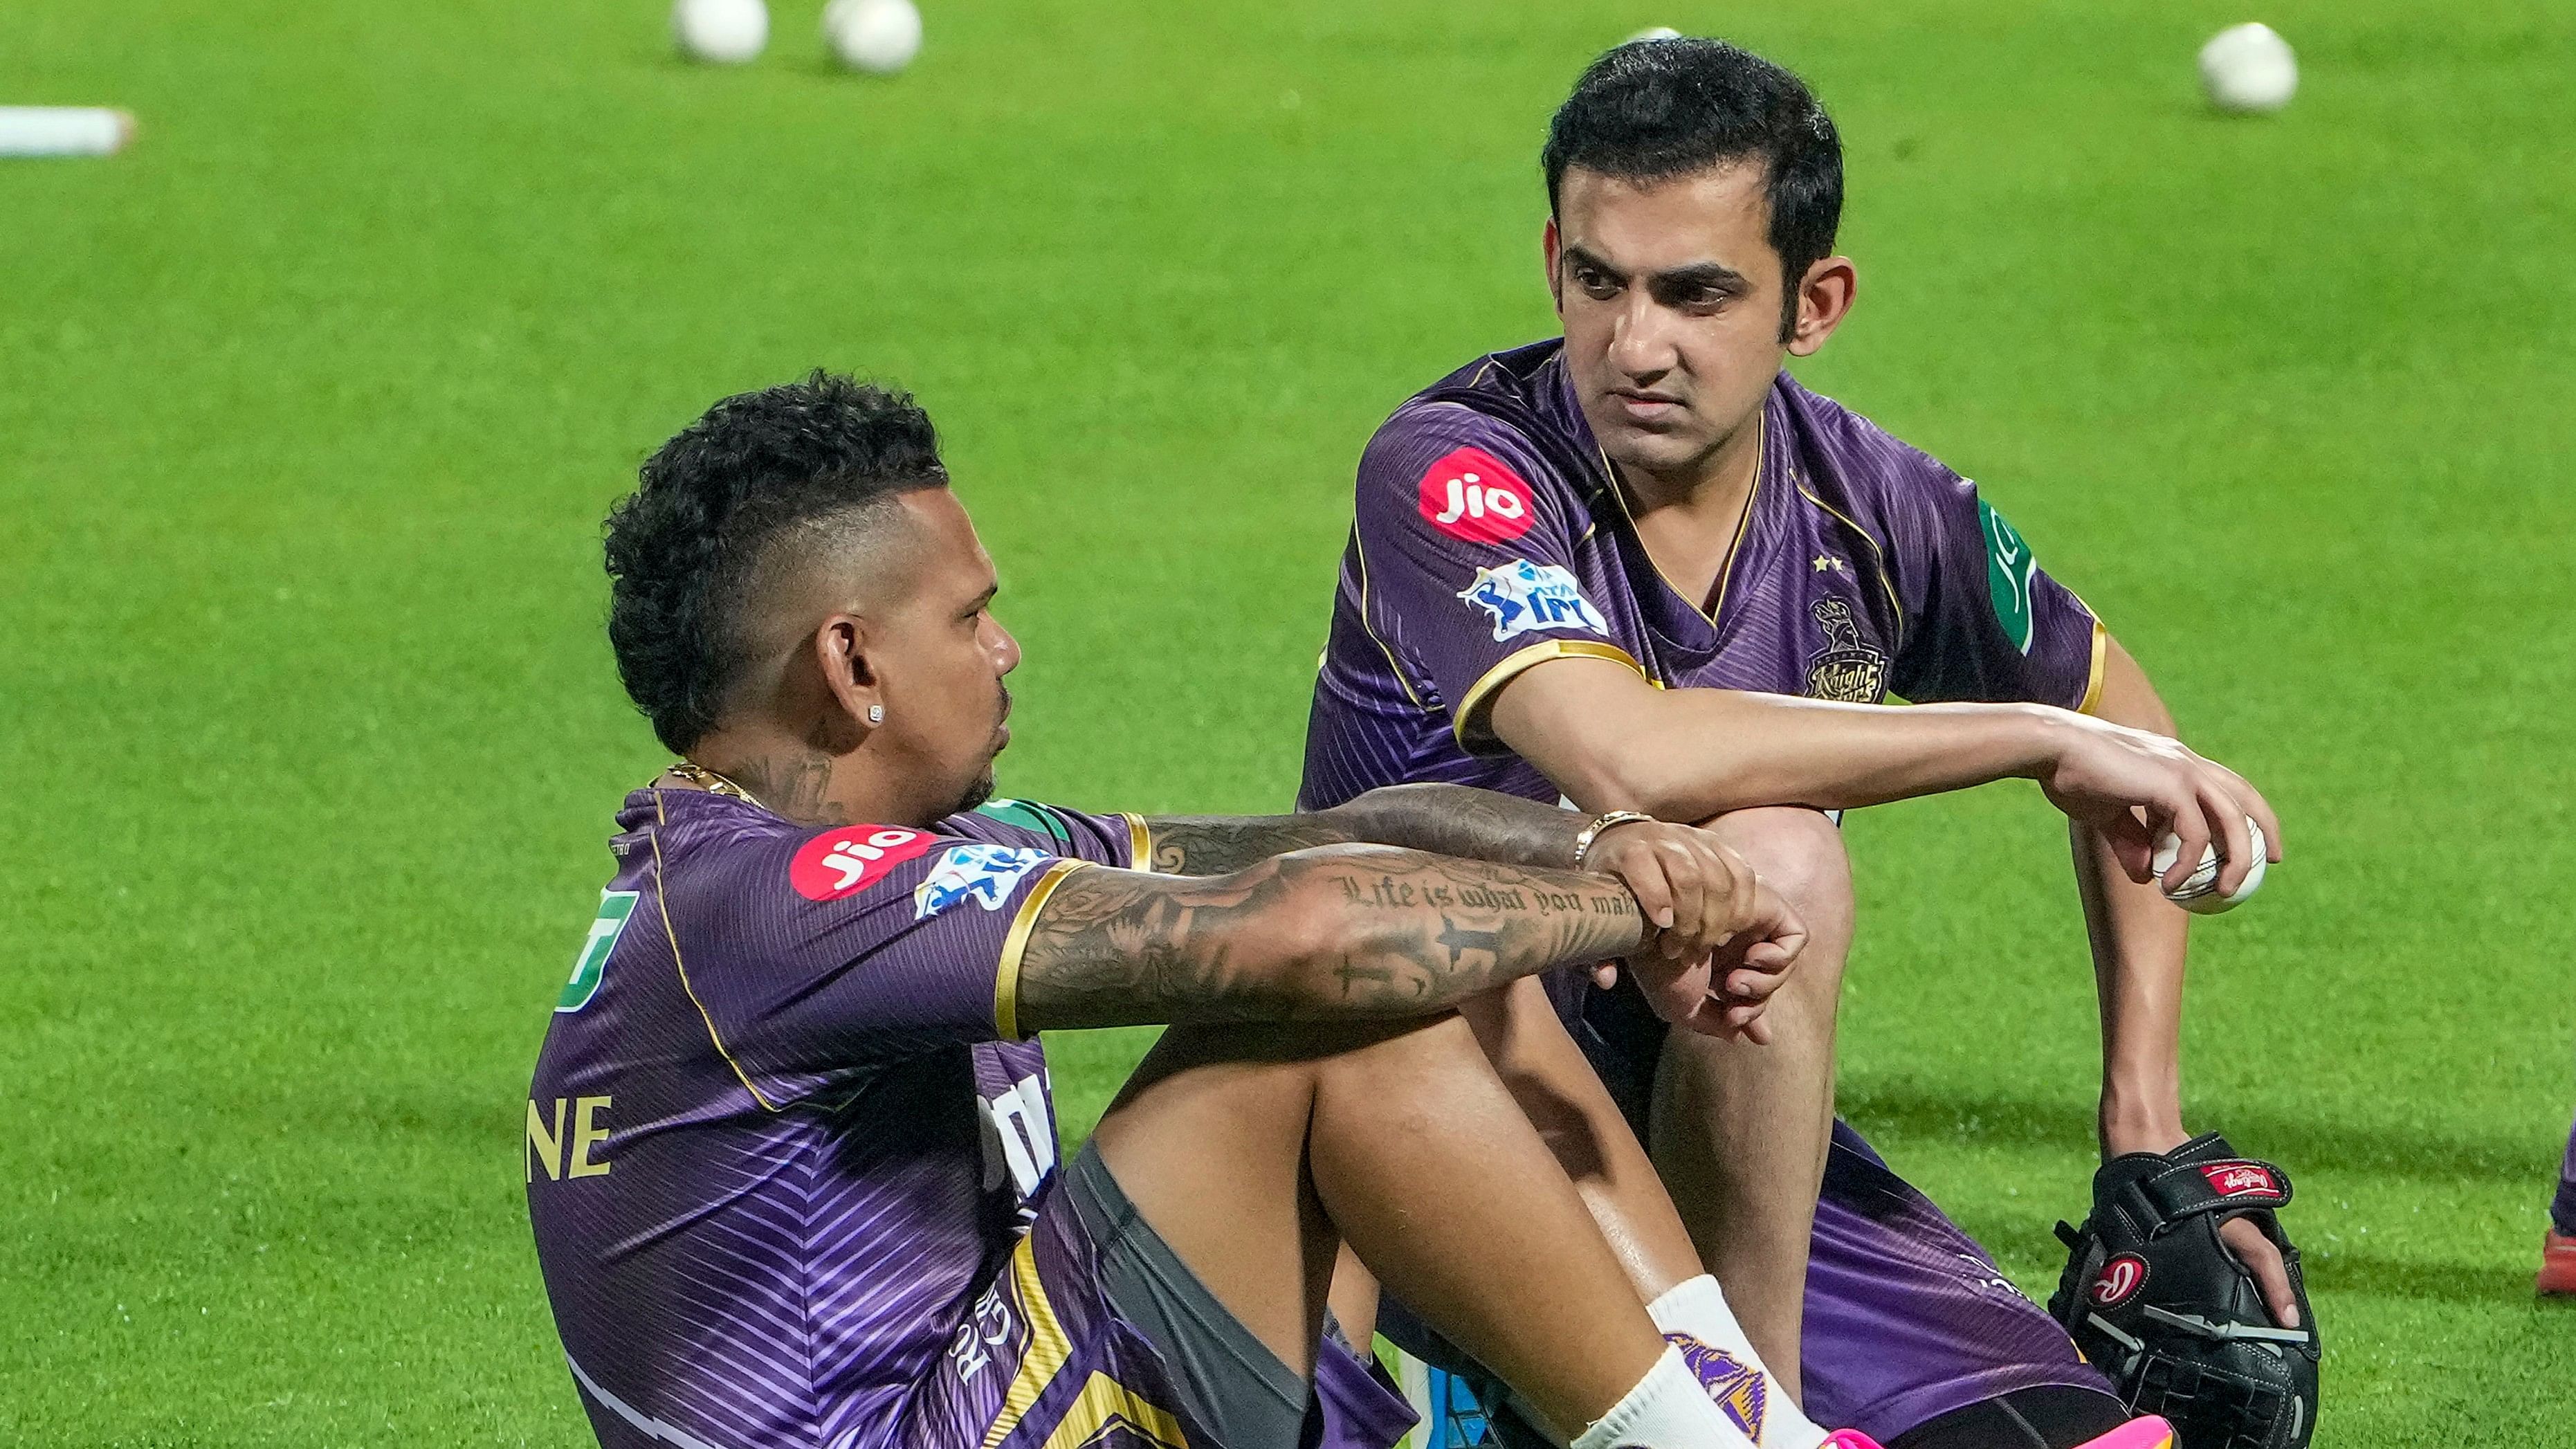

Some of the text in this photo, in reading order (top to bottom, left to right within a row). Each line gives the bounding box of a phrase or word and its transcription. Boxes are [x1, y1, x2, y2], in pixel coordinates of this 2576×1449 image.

[1436, 472, 1525, 525] Jio
[821, 830, 917, 891] Jio
[1338, 875, 1418, 909] Life
[1421, 879, 1454, 908] is
[1456, 881, 1528, 913] what
[1533, 891, 1584, 917] you
